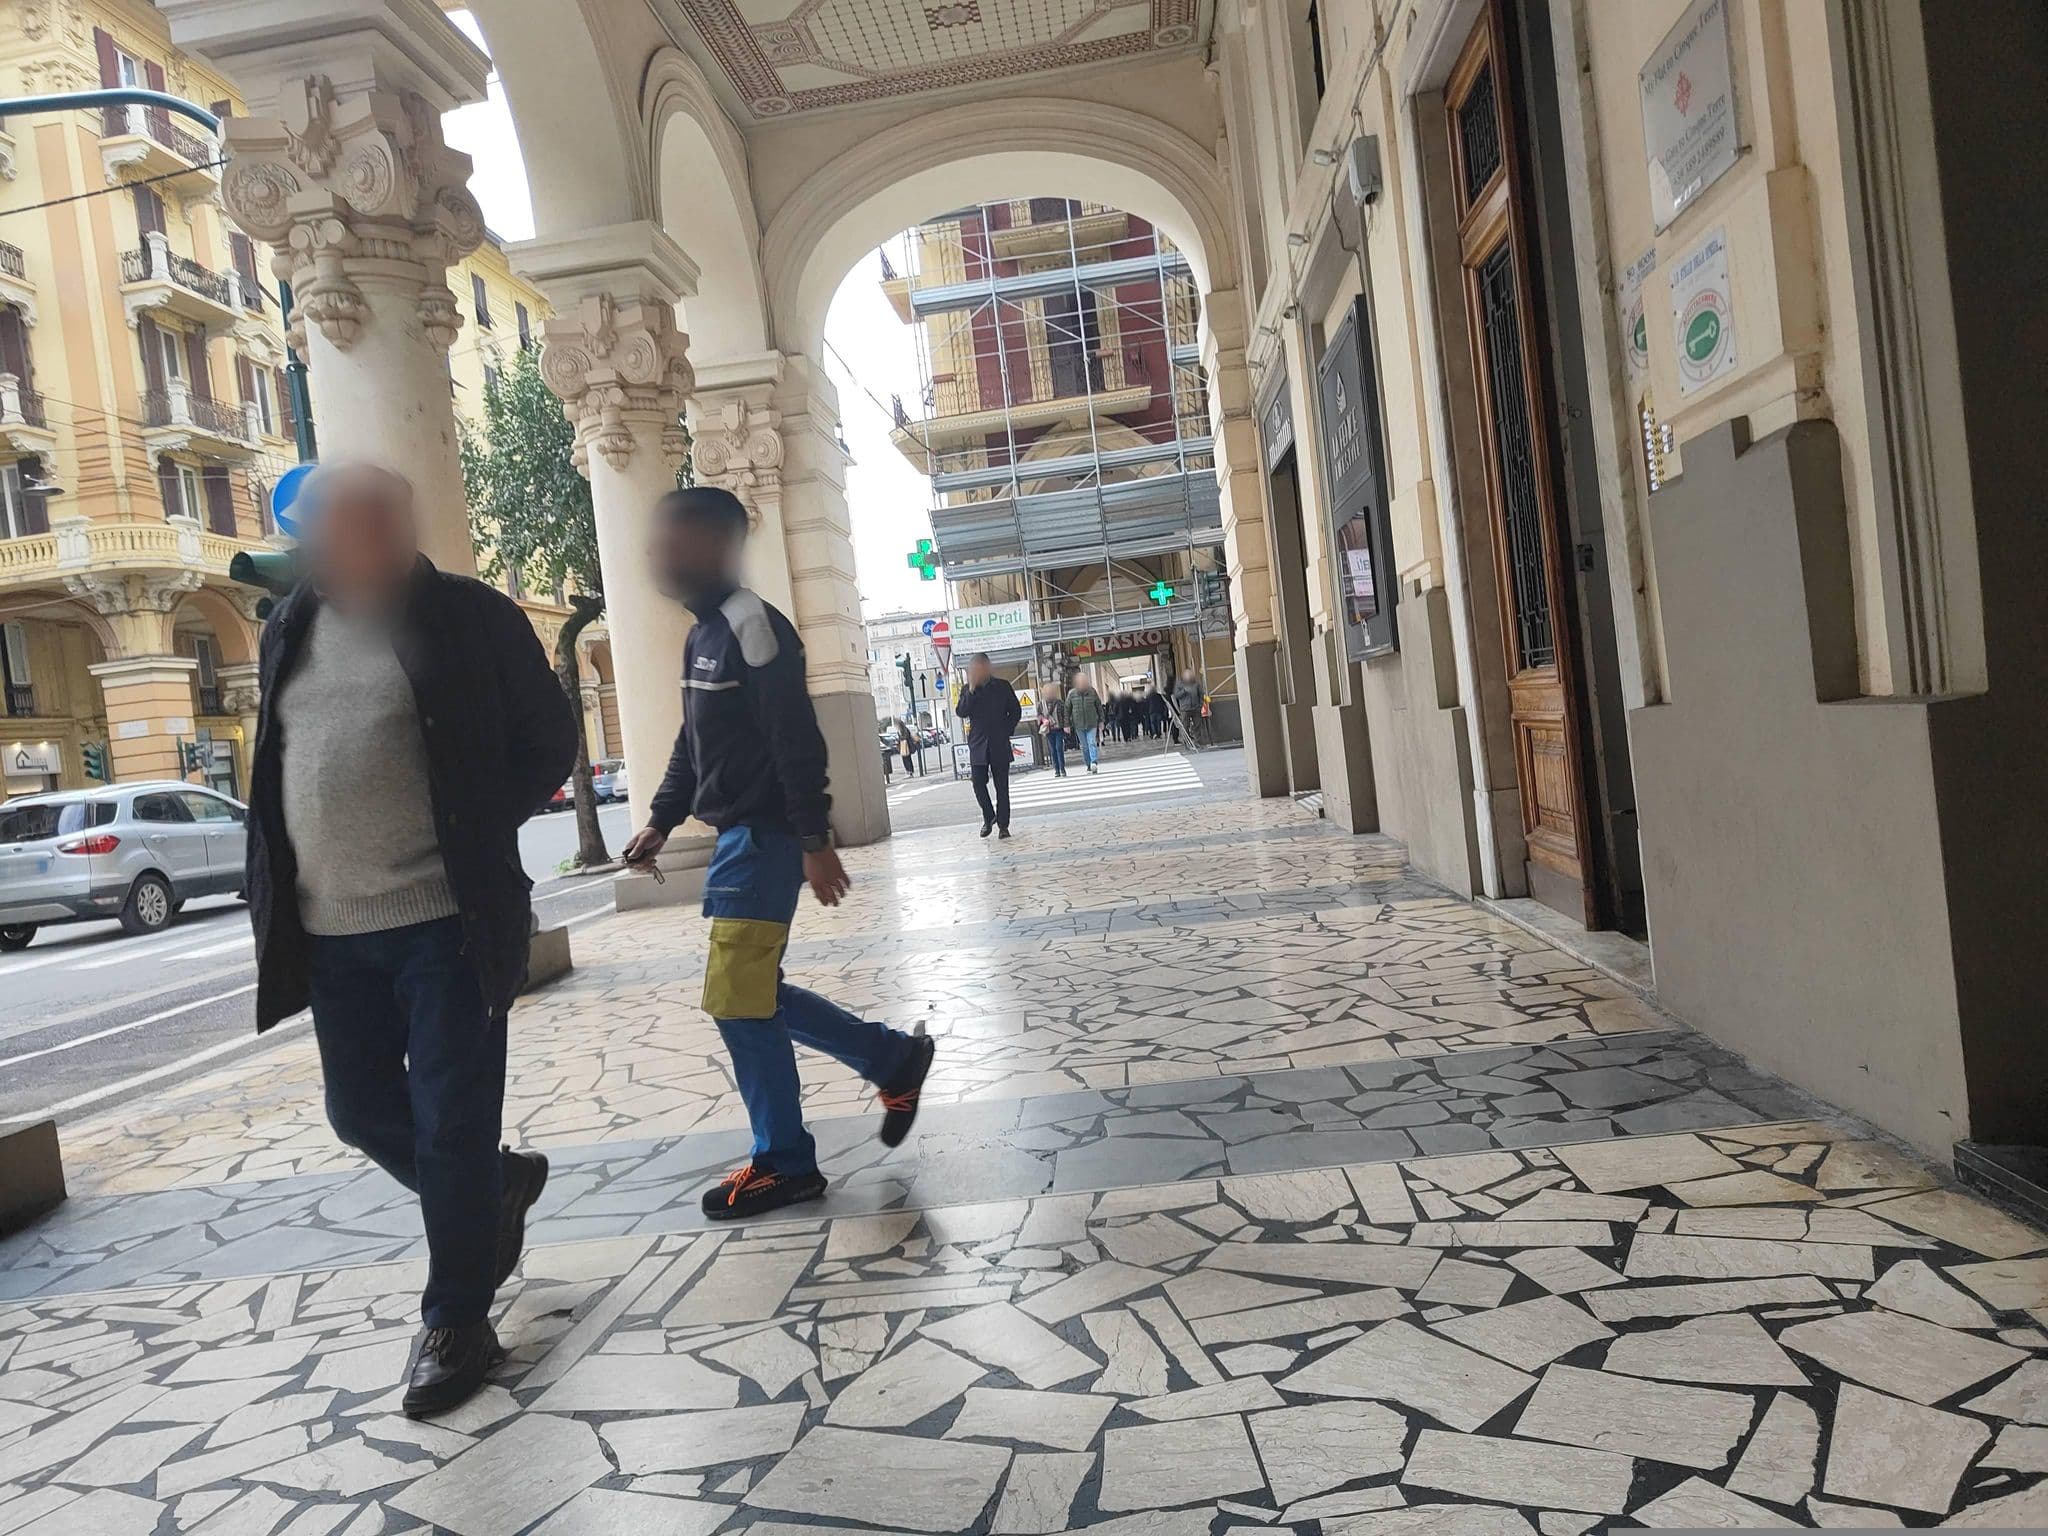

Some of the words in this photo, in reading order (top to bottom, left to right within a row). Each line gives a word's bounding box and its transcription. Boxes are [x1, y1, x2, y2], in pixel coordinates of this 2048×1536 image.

[954, 613, 983, 630] Edil
[988, 608, 1022, 627] Prati
[1094, 630, 1162, 653] BASKO
